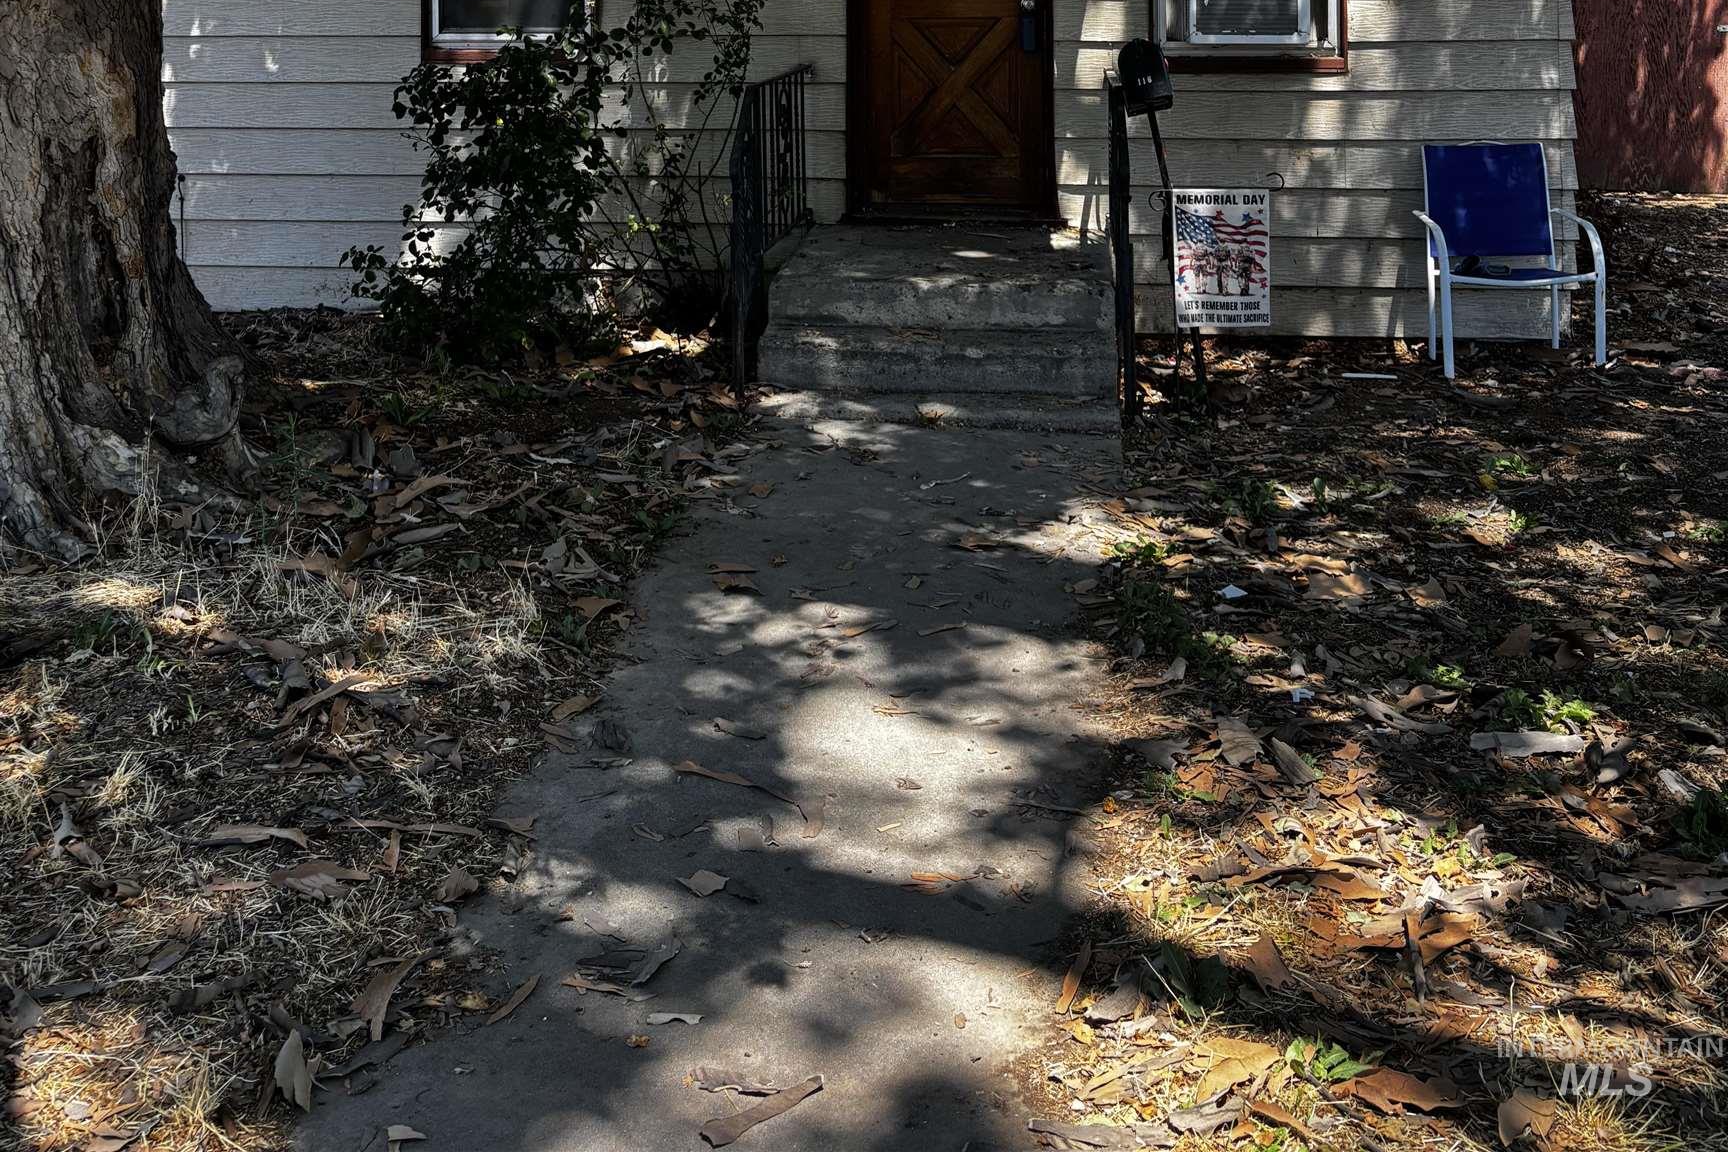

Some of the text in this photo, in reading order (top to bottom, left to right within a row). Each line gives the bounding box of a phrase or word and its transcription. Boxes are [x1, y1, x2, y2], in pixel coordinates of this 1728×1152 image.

[1137, 75, 1152, 86] 116
[1176, 194, 1265, 206] MEMORIAL DAY
[1184, 300, 1261, 311] LET'S REMEMBER THOSE
[1206, 314, 1216, 324] THE
[1217, 314, 1242, 324] ULTIMATE
[1243, 314, 1270, 324] SACRIFICE
